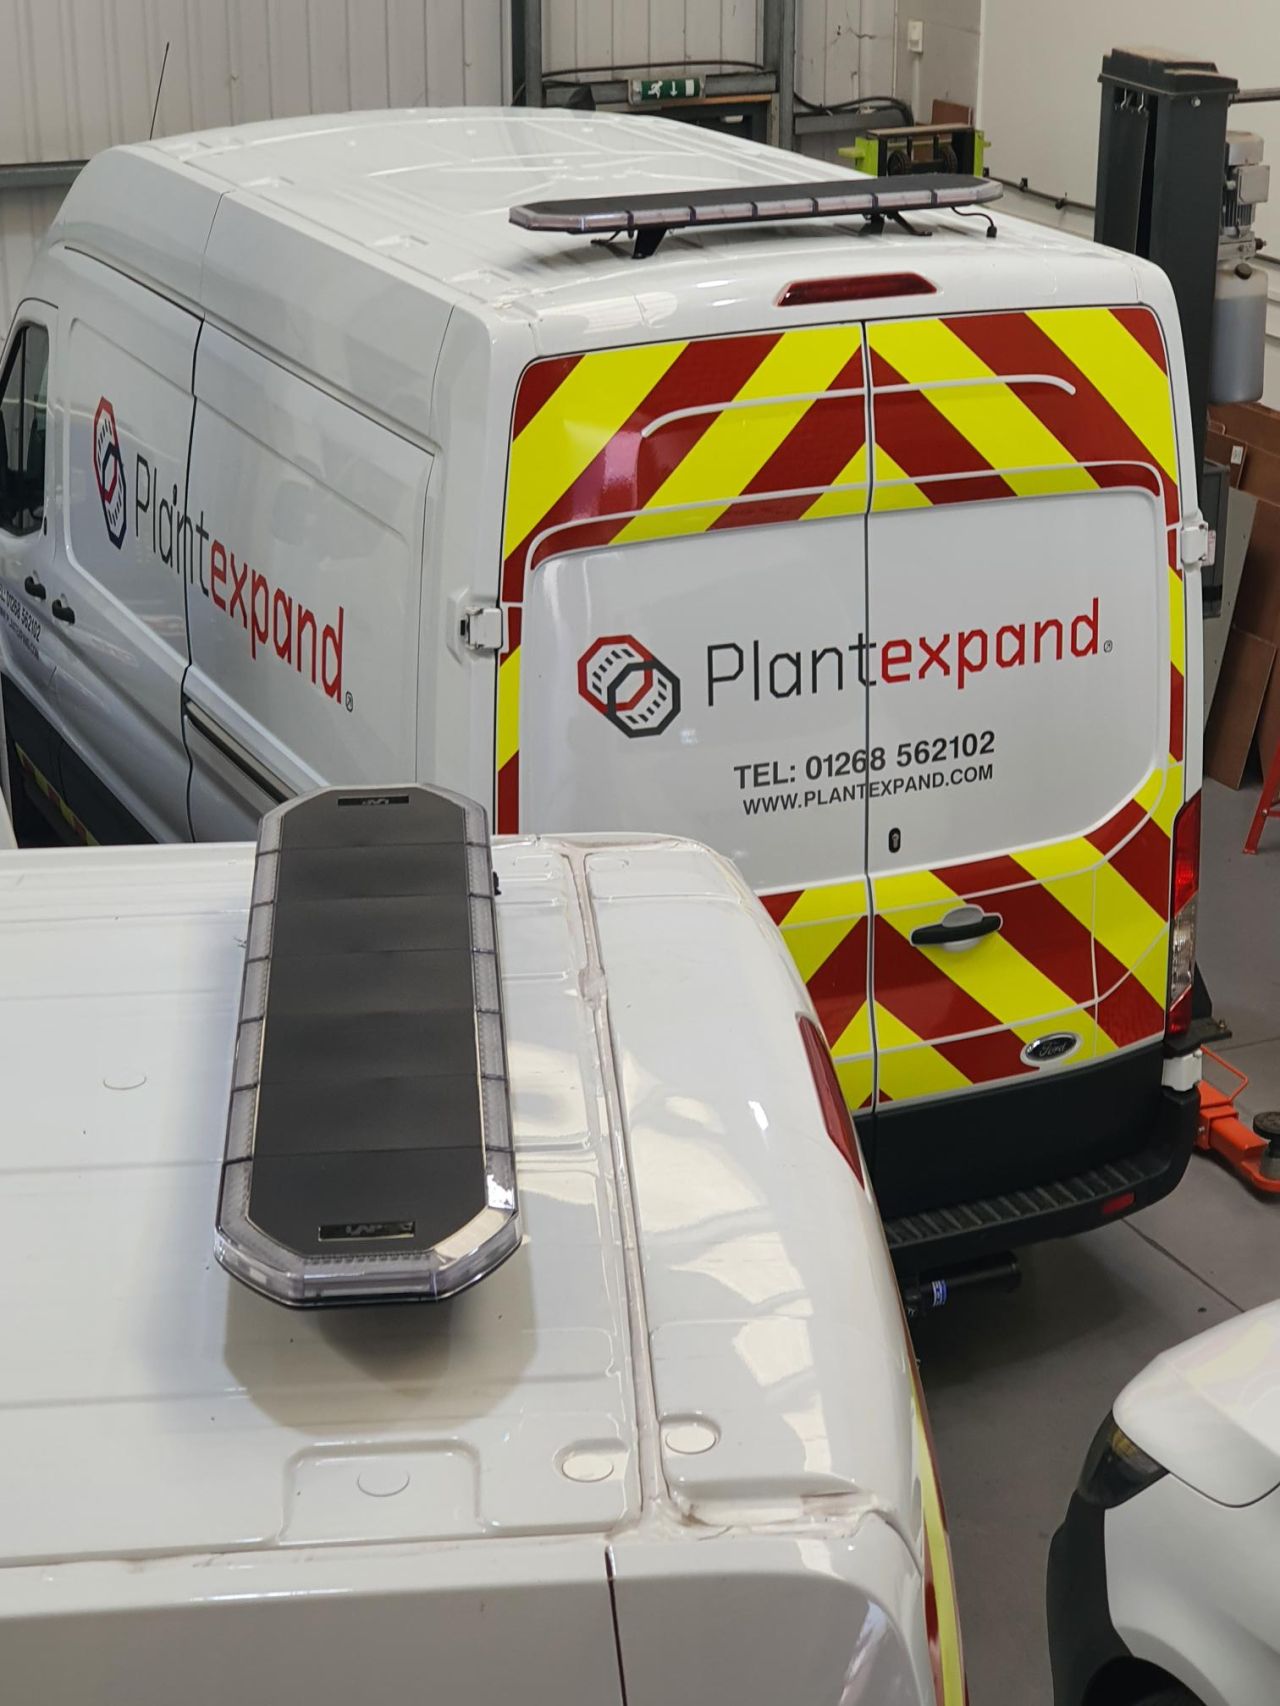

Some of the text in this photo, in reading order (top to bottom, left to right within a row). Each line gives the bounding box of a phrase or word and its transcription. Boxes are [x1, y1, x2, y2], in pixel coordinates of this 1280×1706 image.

[734, 730, 995, 790] TEL: 01268 562102
[743, 764, 993, 815] WWW.PLANTEXPAND.COM
